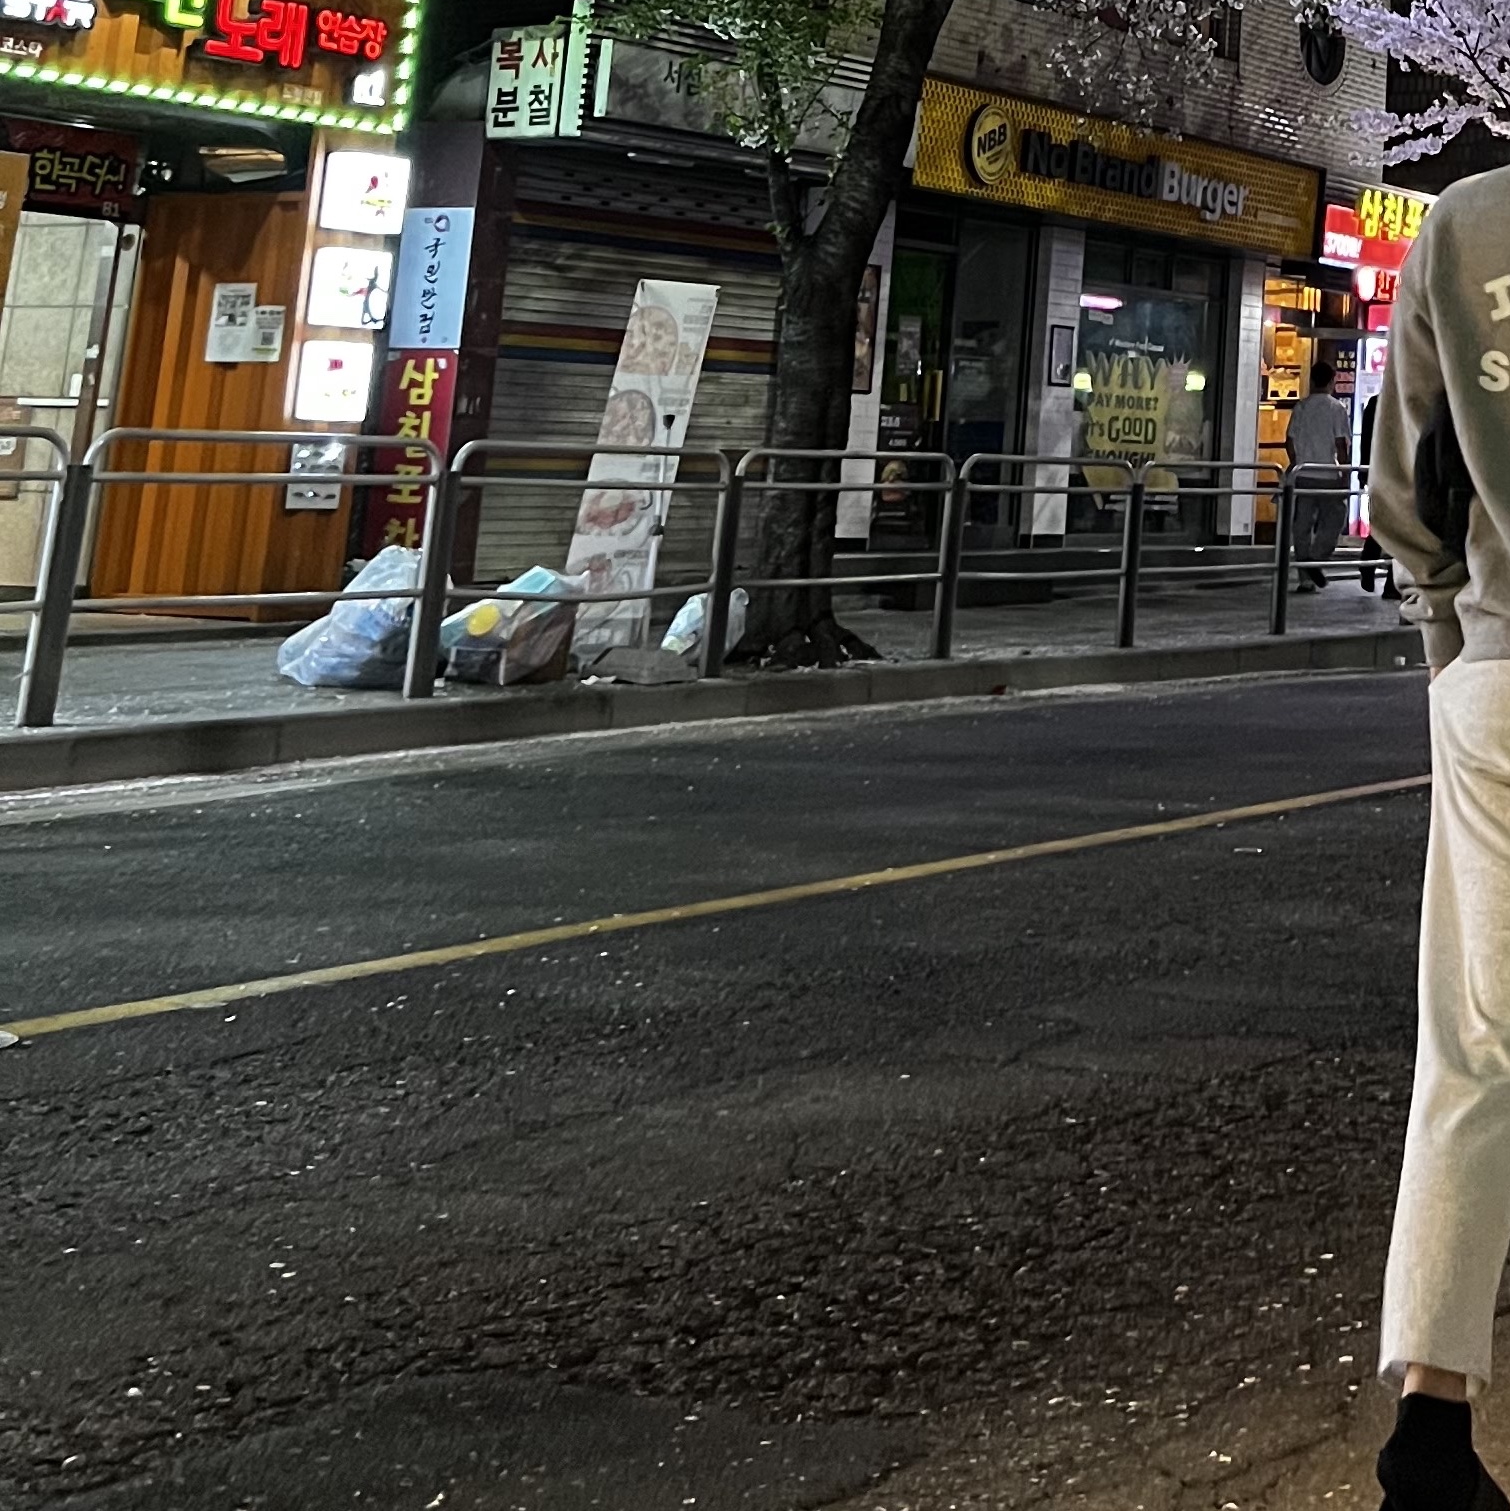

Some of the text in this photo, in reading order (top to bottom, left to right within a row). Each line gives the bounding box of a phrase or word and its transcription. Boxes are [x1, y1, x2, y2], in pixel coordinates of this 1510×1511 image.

[317, 9, 388, 61] 연습장
[496, 37, 560, 80] 복사
[490, 83, 554, 128] 분철
[976, 122, 1007, 158] NBB
[1024, 131, 1250, 222] No Brand Burger
[1361, 188, 1434, 241] 삼칠포
[1114, 394, 1160, 412] MORE?
[1107, 415, 1158, 445] GOOD
